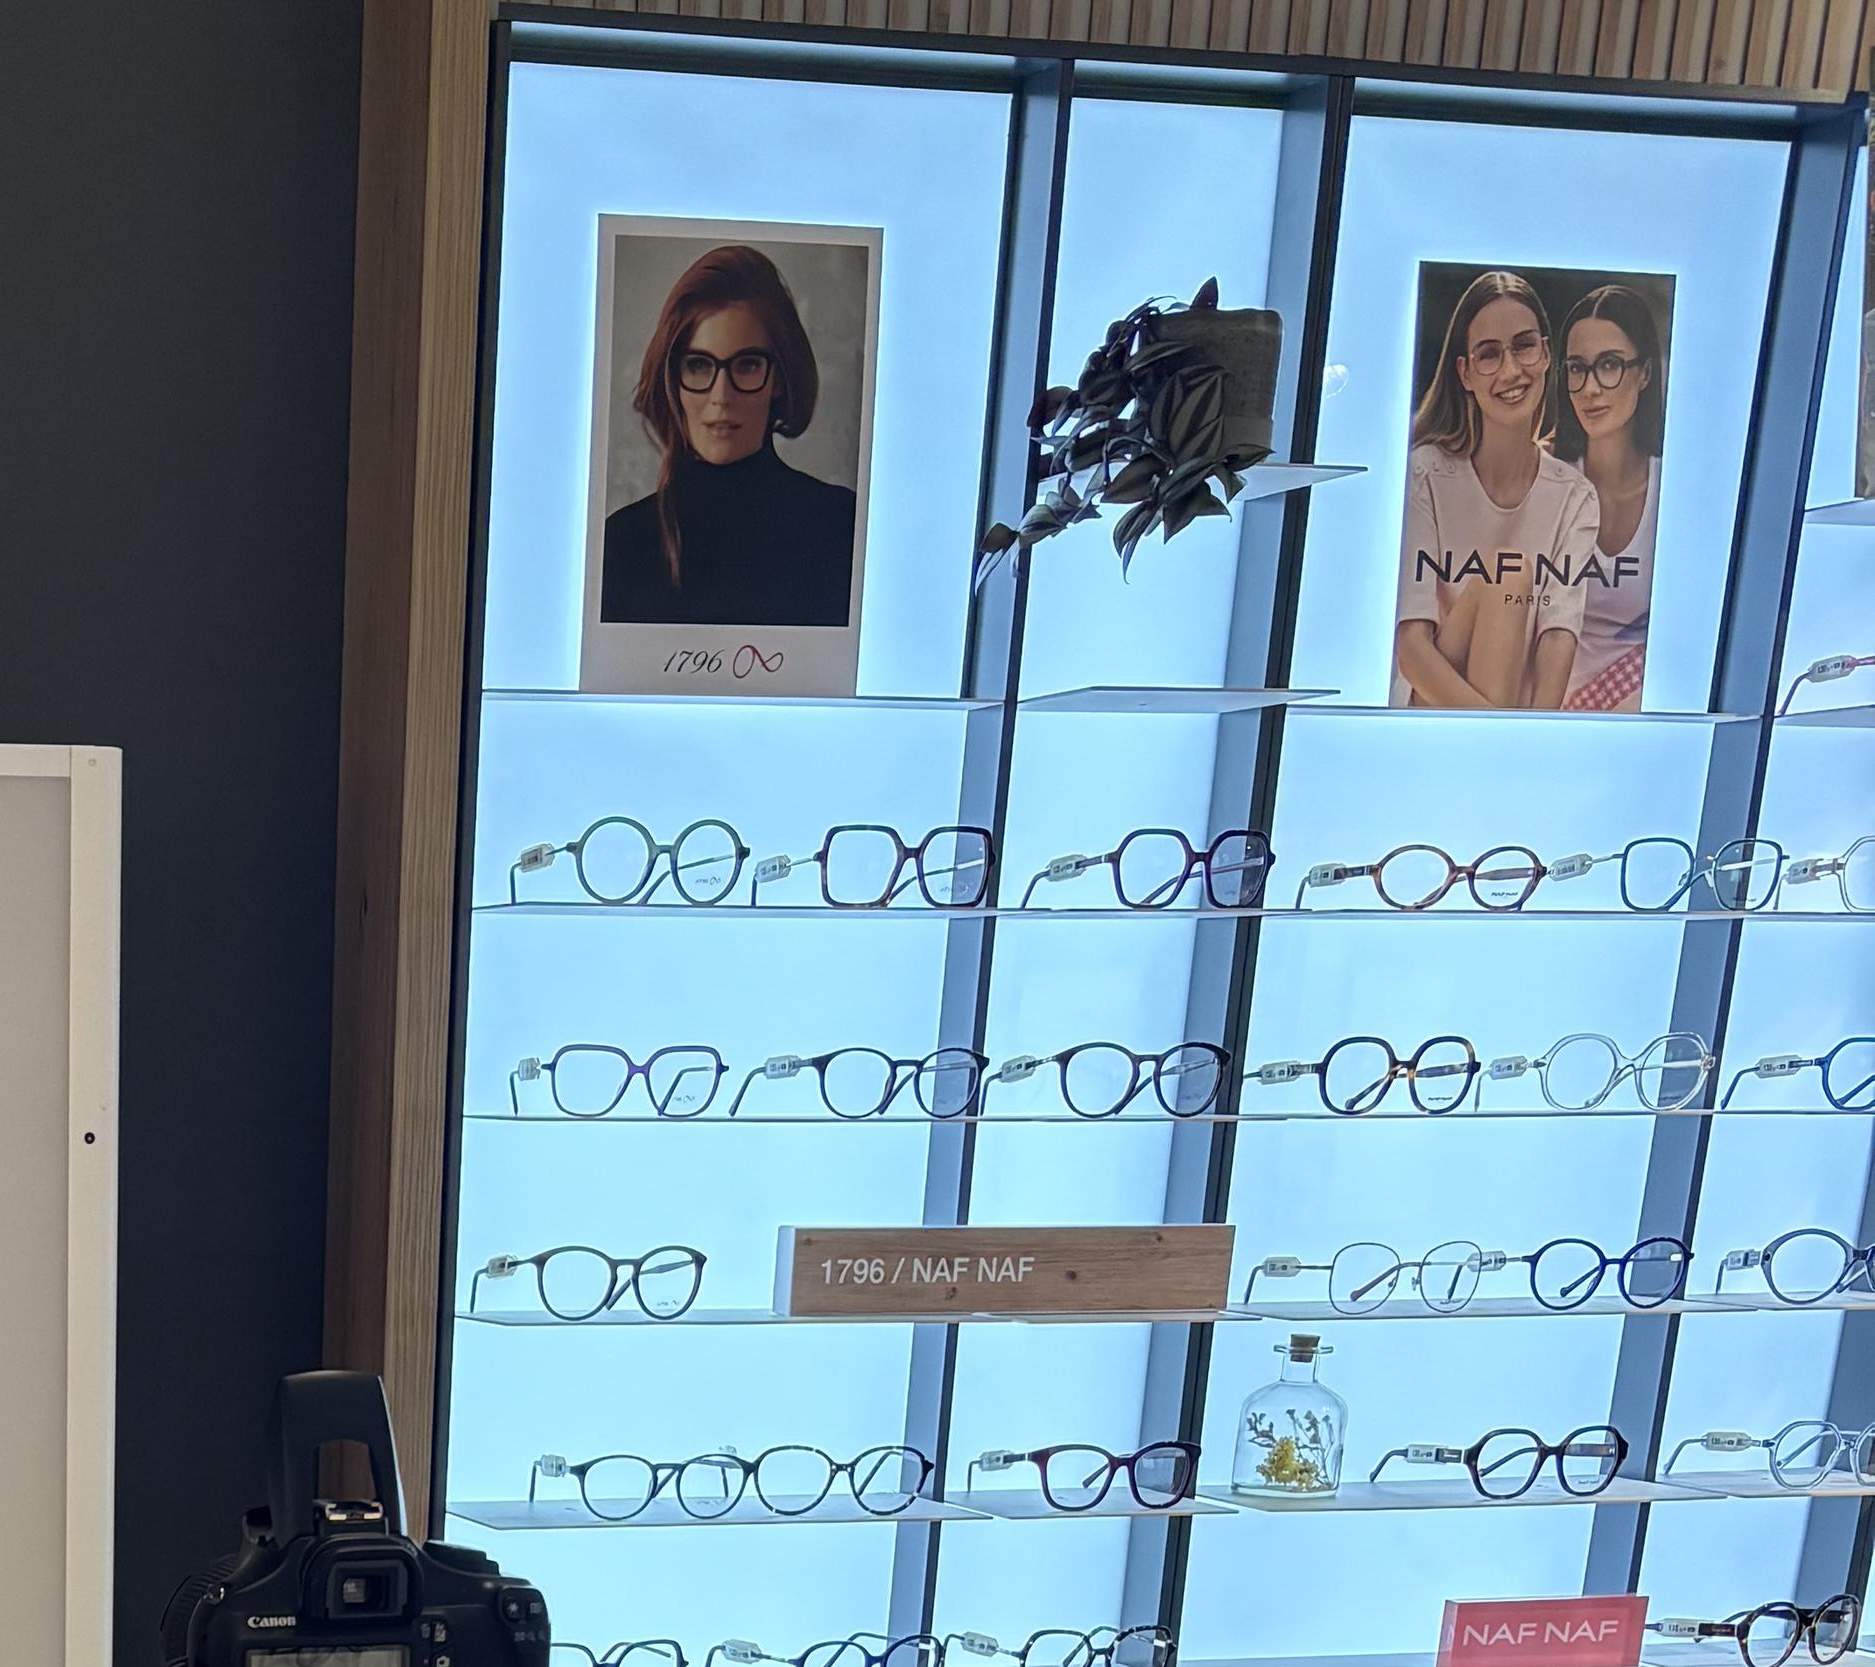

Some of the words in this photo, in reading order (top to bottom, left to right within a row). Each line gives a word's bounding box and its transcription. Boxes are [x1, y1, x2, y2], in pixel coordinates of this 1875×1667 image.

[1415, 549, 1523, 585] NAF
[1534, 552, 1640, 589] NAF
[1504, 594, 1552, 607] PARIS
[663, 649, 725, 675] 1796
[821, 1258, 885, 1284] 1796
[891, 1257, 905, 1284] /
[912, 1257, 971, 1283] NAF
[977, 1256, 1035, 1283] NAF
[247, 1616, 296, 1628] Canon
[1462, 1622, 1537, 1646] NAF
[1544, 1620, 1619, 1644] NAF
